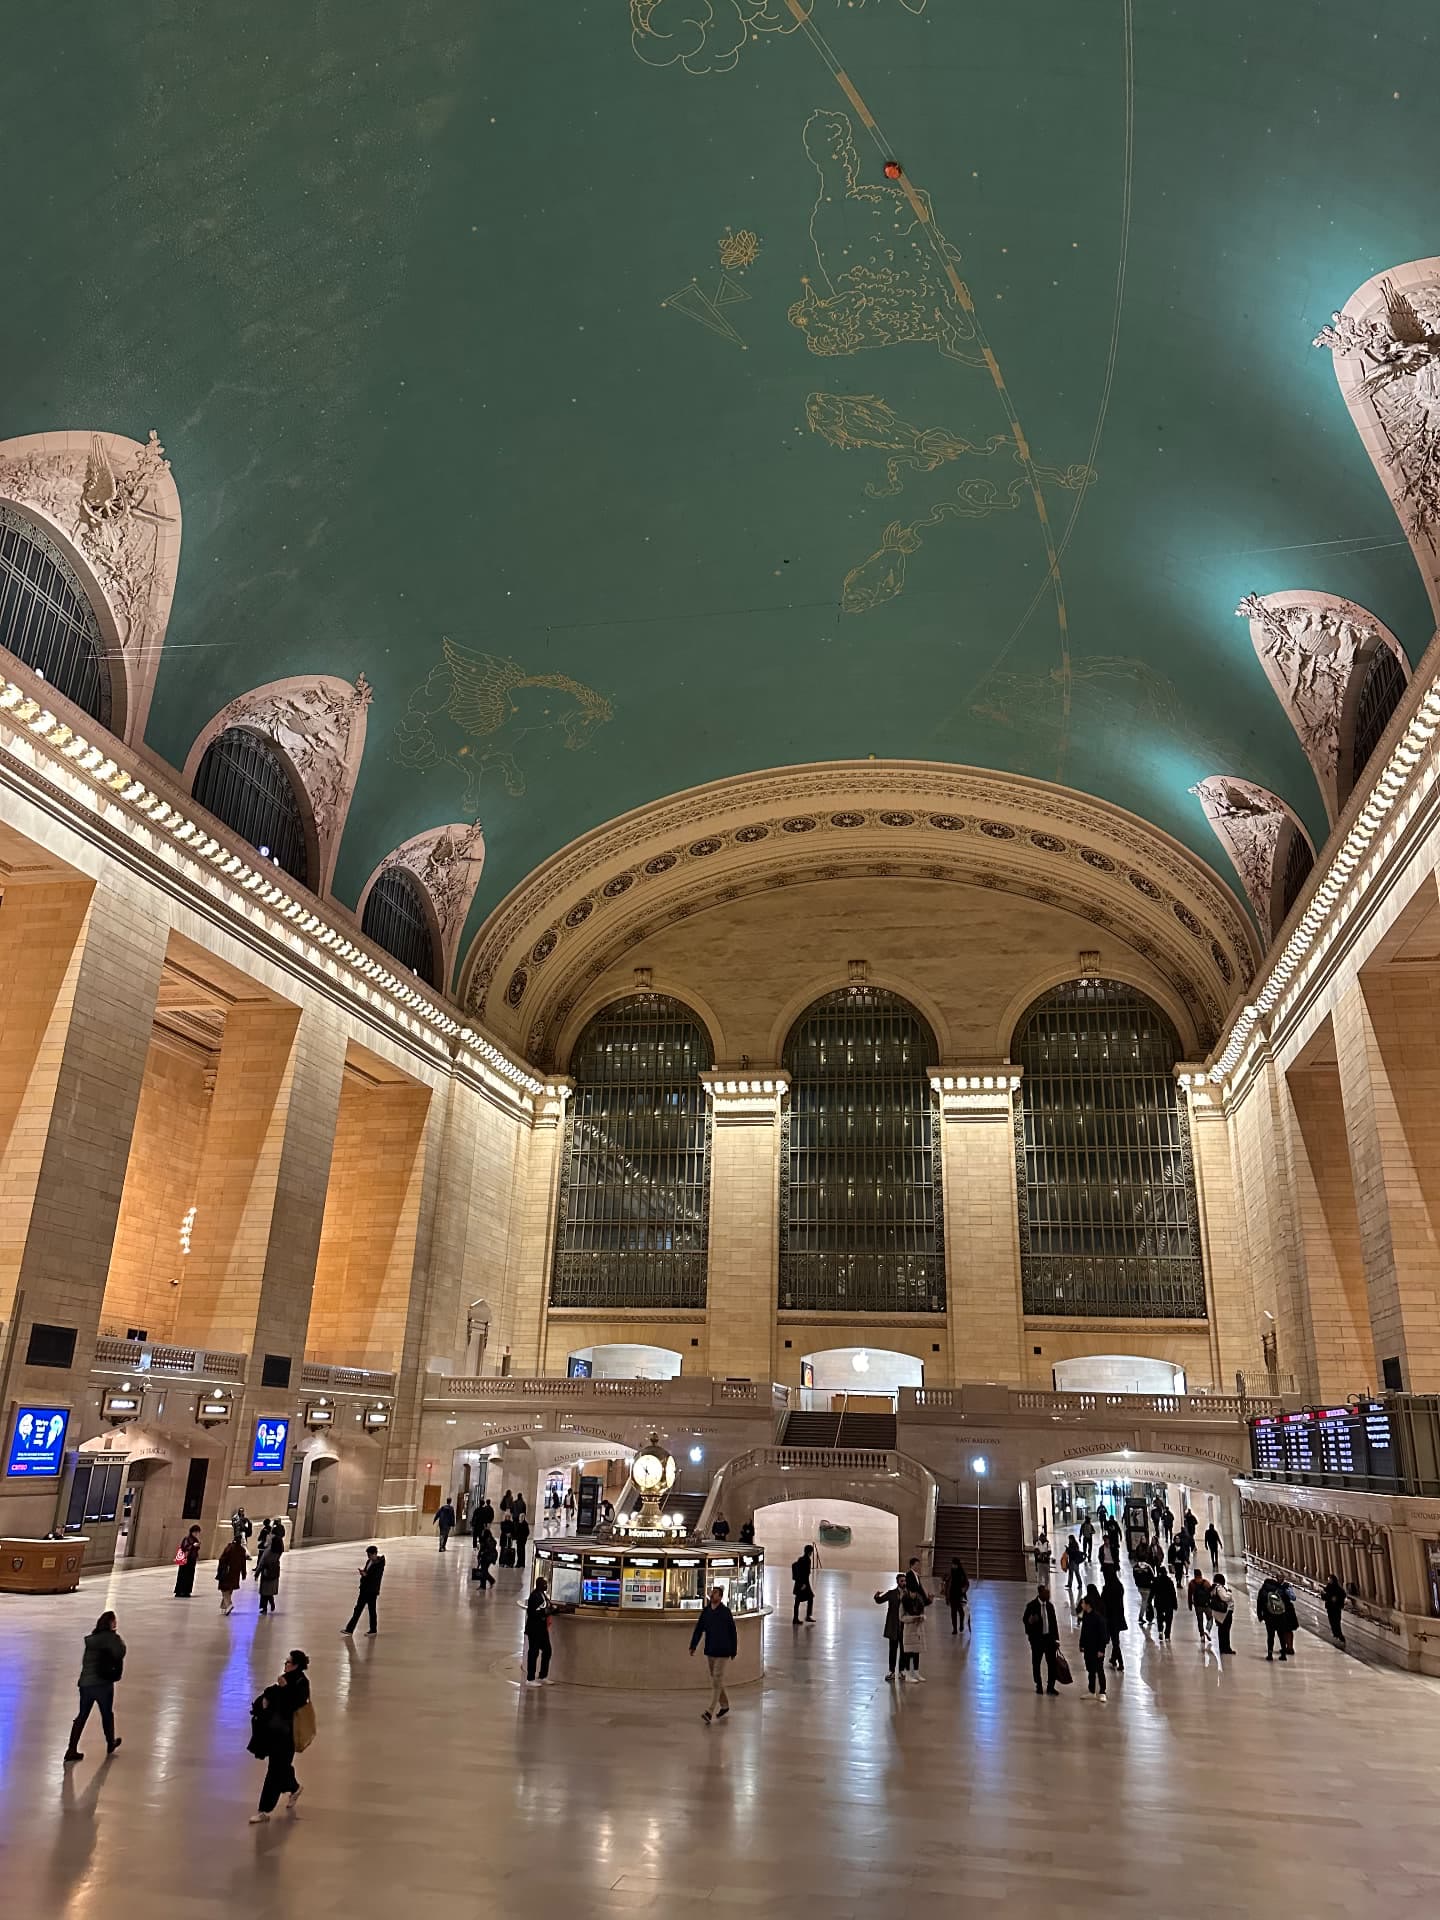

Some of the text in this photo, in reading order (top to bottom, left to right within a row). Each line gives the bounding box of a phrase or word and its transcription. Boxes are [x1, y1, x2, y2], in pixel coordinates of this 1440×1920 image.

[484, 1426, 511, 1436] TRACKS
[1063, 1441, 1129, 1457] LEXINGTON AVE
[1161, 1442, 1240, 1465] TICKET MACHINES
[1072, 1468, 1098, 1478] STREET
[1100, 1467, 1130, 1475] PASSAGE
[1134, 1468, 1165, 1478] SUBWAY
[628, 1528, 666, 1538] Information
